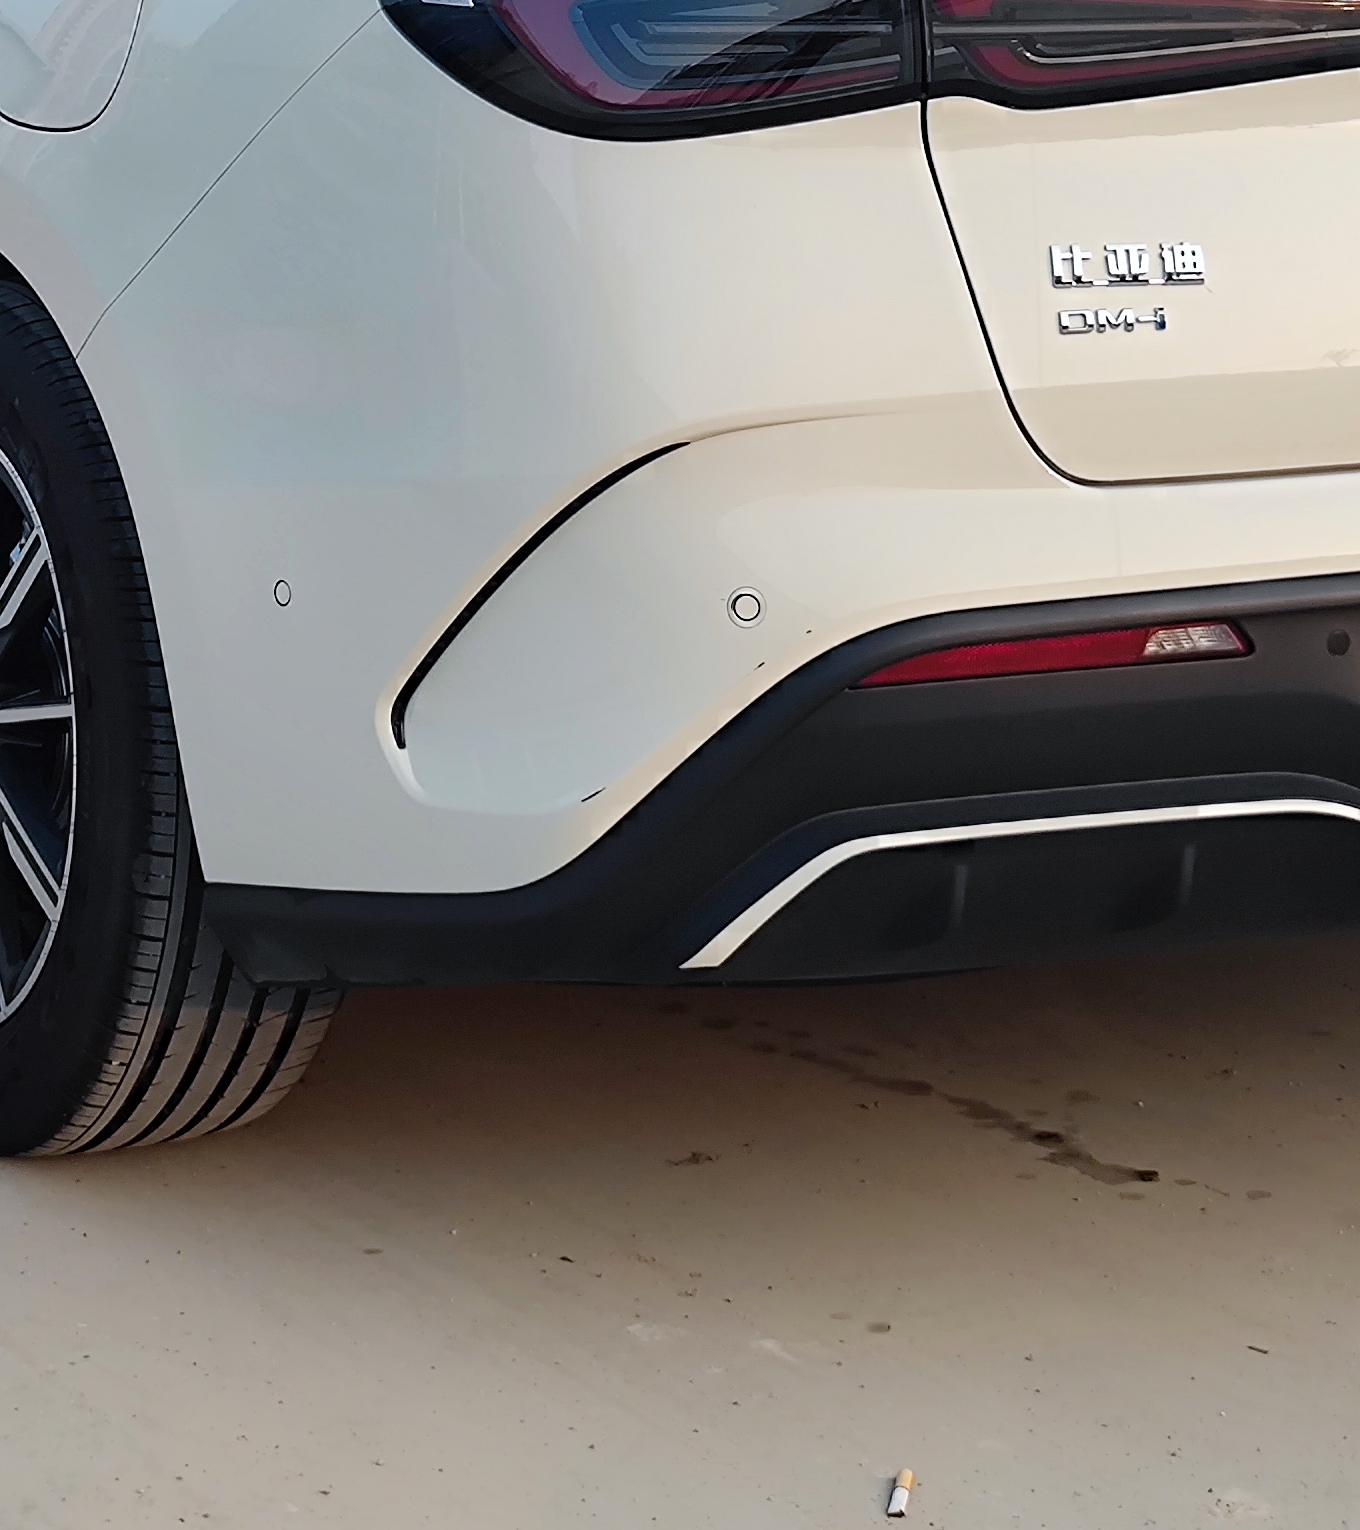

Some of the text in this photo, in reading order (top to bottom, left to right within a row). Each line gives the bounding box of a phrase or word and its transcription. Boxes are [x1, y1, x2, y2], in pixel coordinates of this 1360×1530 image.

[1049, 242, 1206, 288] 比亚迪
[1058, 307, 1167, 335] DM-i
